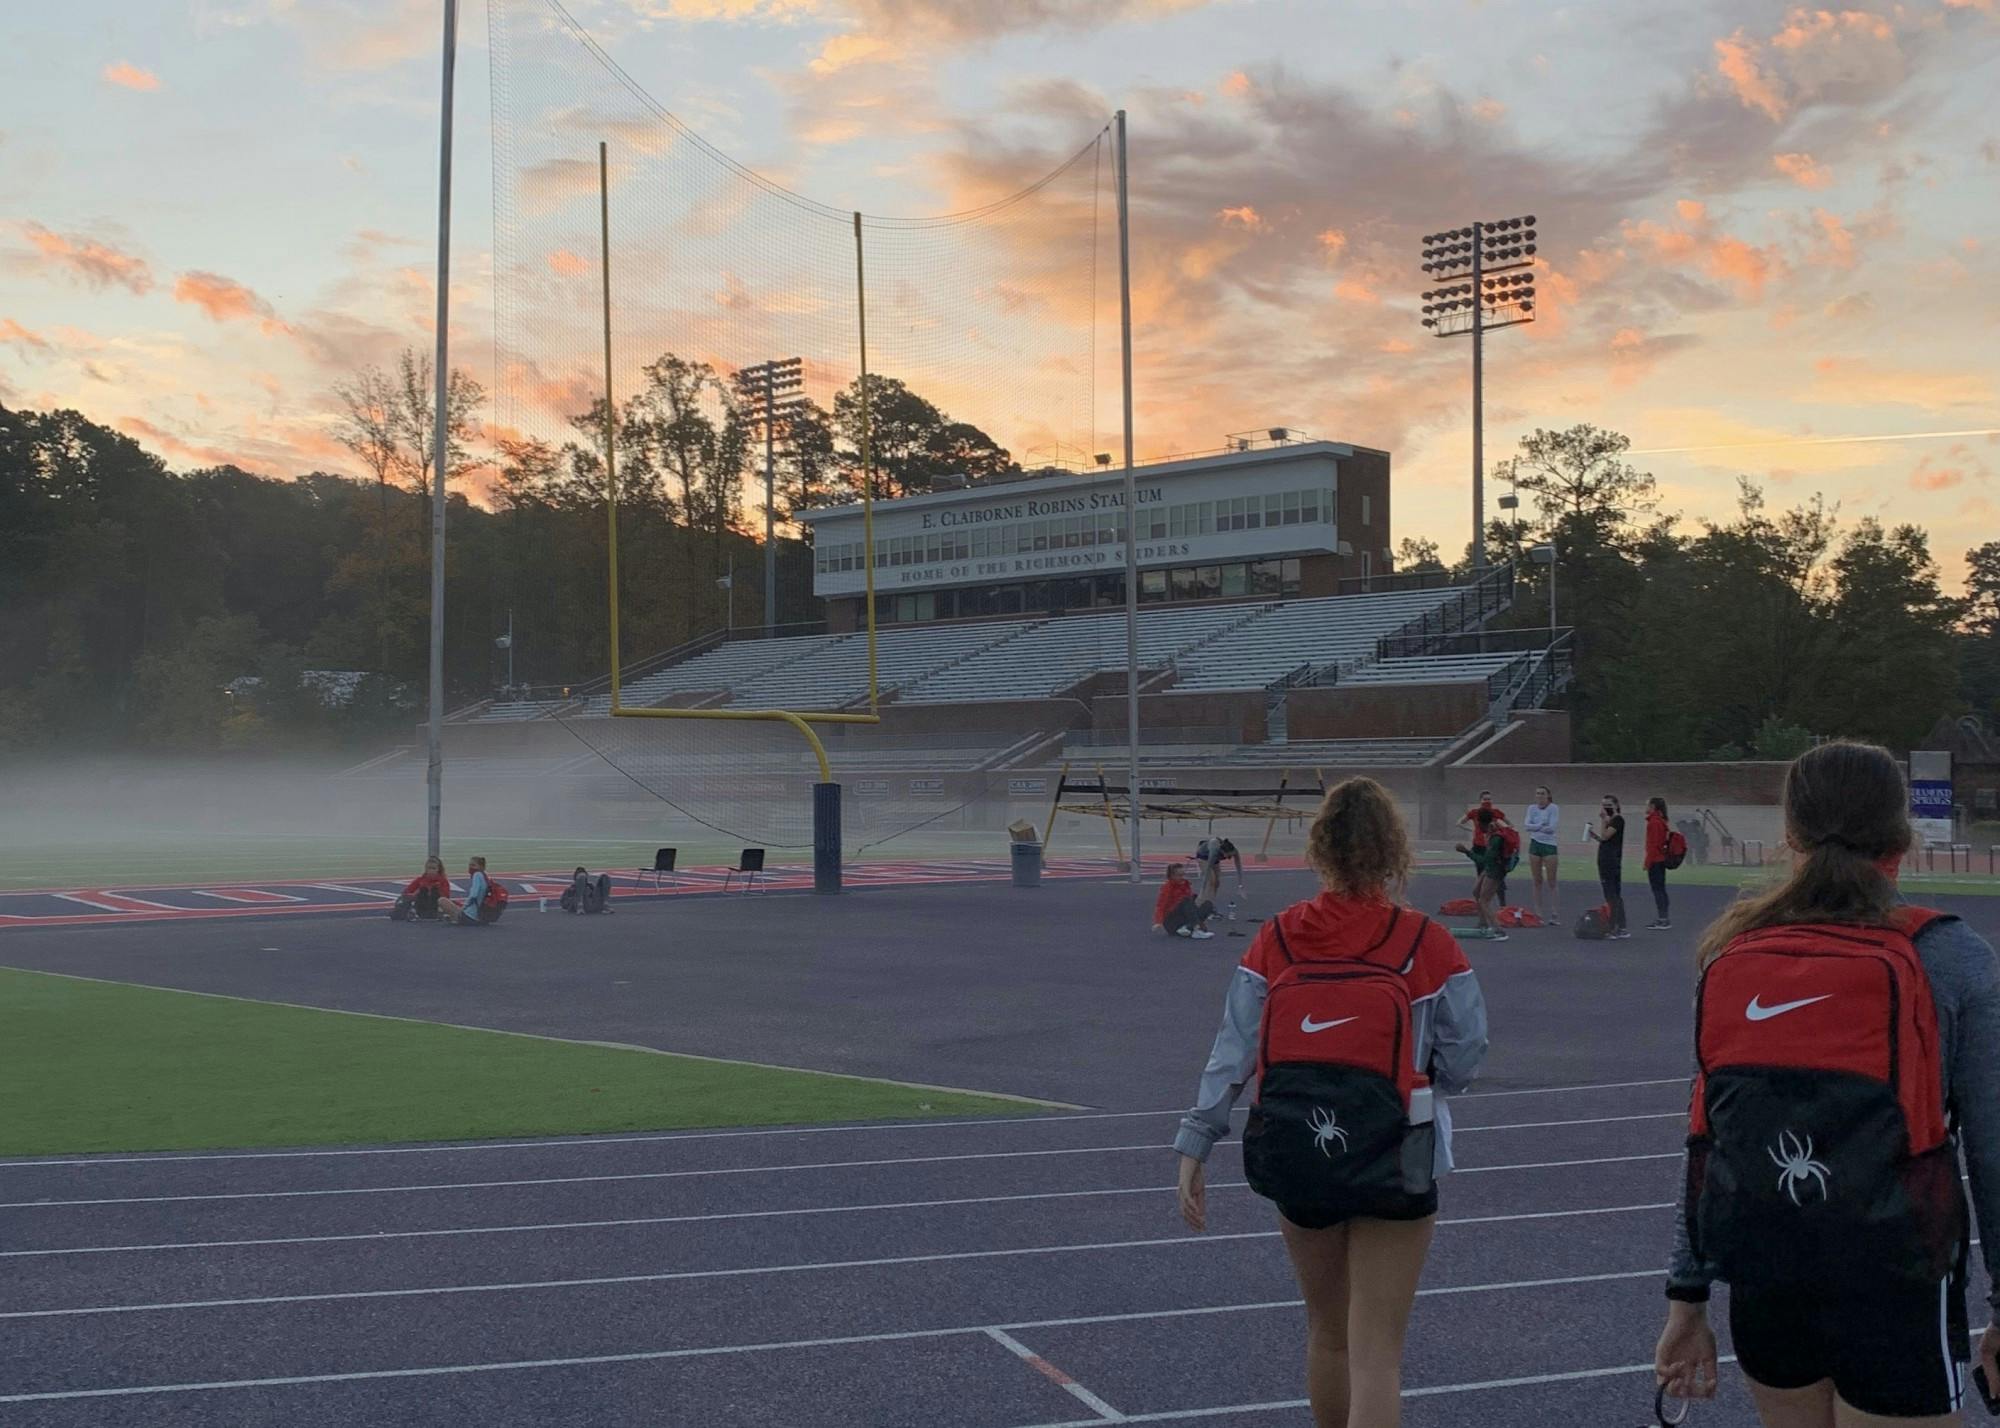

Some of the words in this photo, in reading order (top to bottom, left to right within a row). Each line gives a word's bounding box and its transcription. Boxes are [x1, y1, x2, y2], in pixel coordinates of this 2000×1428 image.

[922, 512, 936, 528] E.
[1090, 487, 1162, 510] STAUM
[901, 567, 944, 583] HOME
[950, 565, 969, 578] OF
[978, 561, 1008, 576] THE
[1014, 551, 1106, 572] RICHMOND
[1114, 543, 1190, 562] SIDERS
